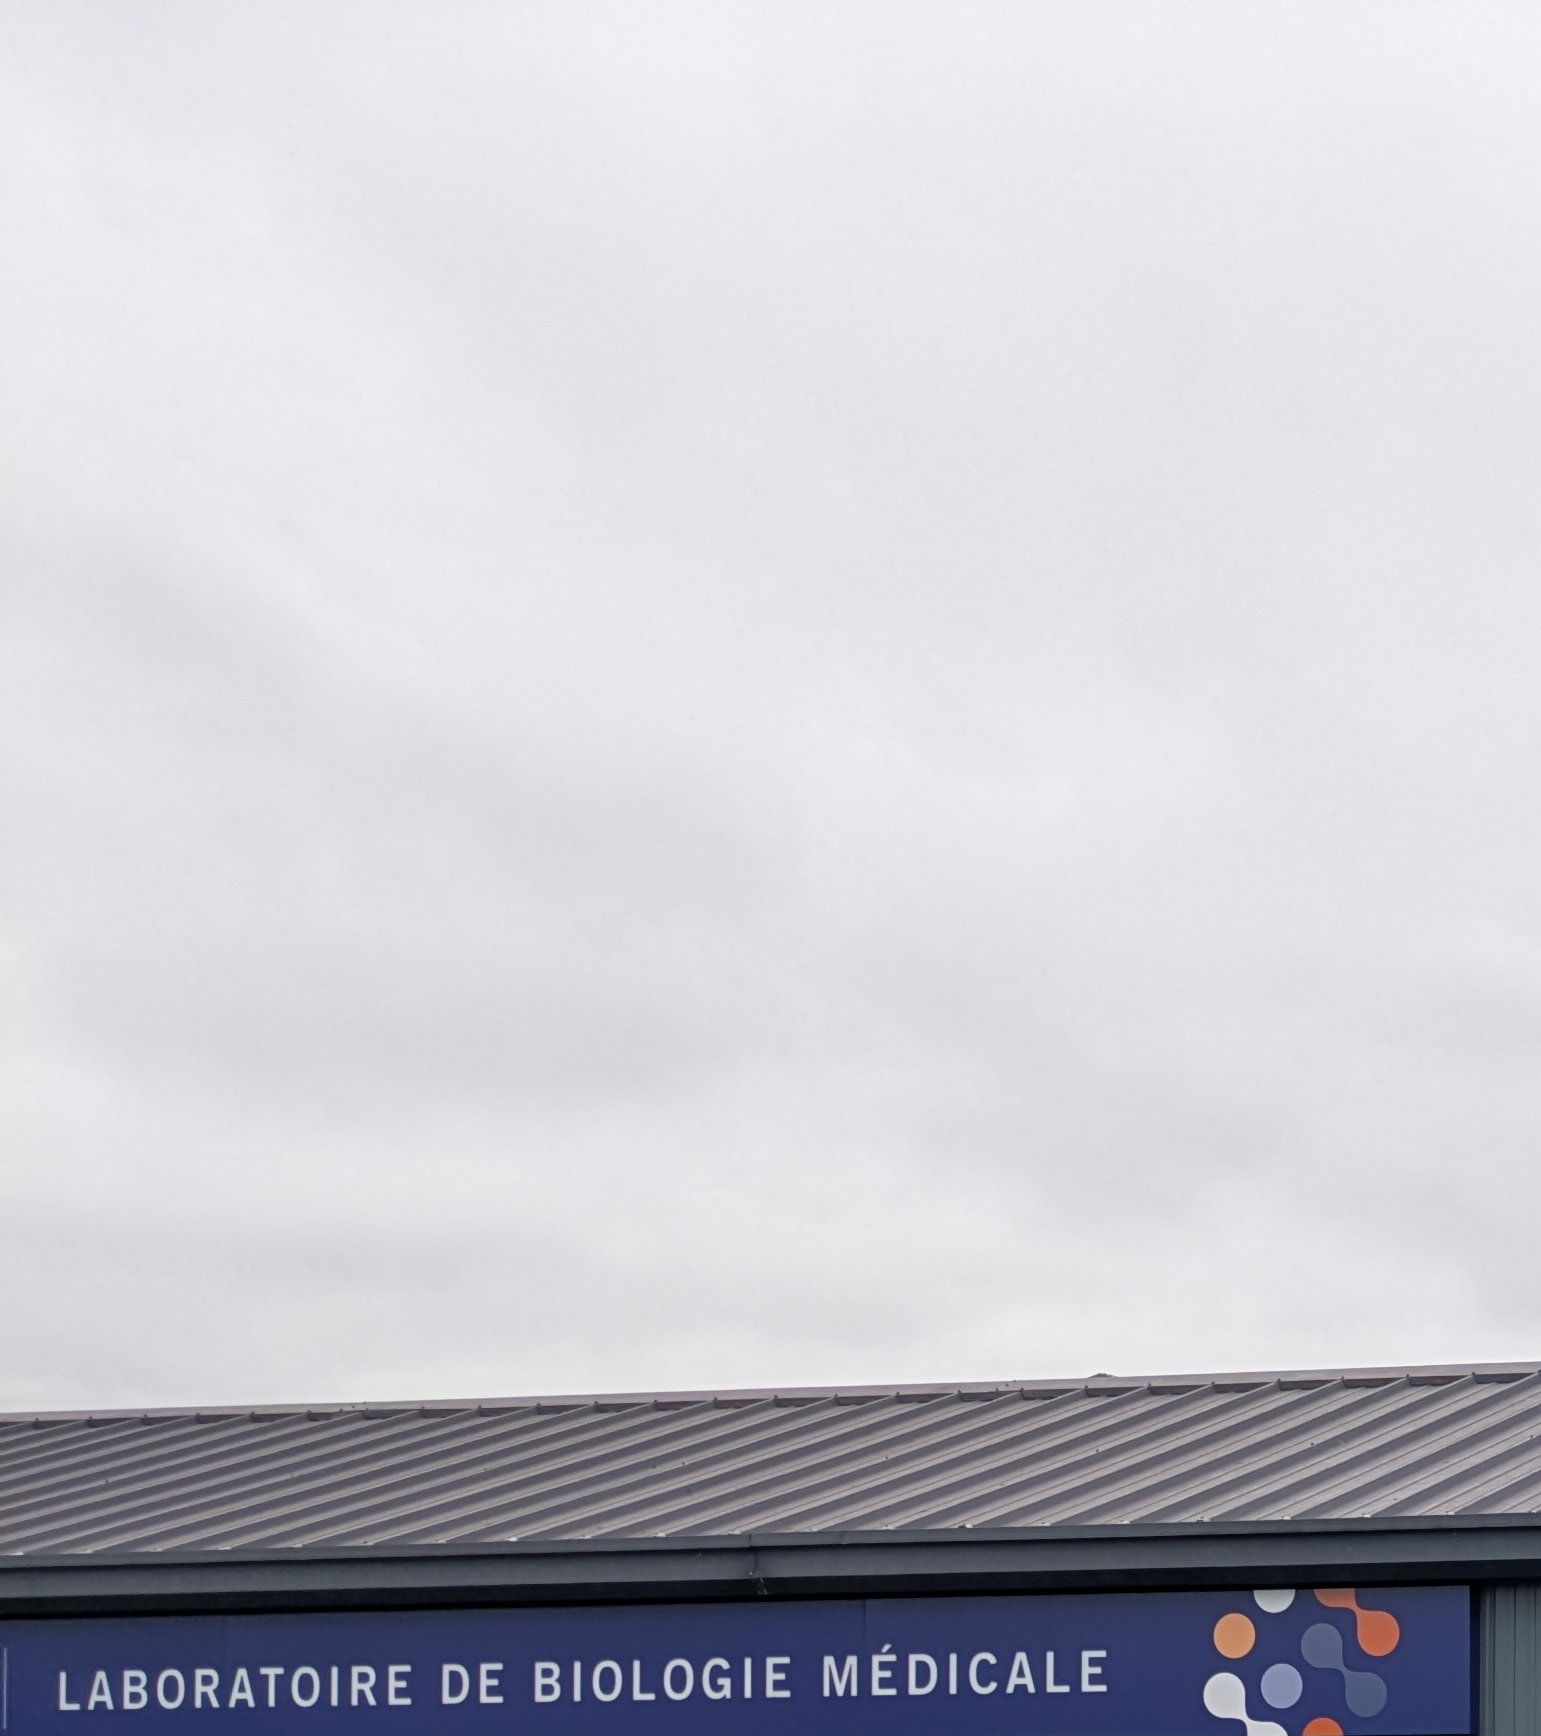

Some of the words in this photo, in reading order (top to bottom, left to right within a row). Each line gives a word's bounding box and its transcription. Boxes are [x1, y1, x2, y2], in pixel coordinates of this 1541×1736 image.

[58, 1664, 412, 1711] LABORATOIRE
[441, 1662, 504, 1705] DE
[534, 1656, 792, 1703] BIOLOGIE
[822, 1643, 1108, 1698] MÉDICALE
